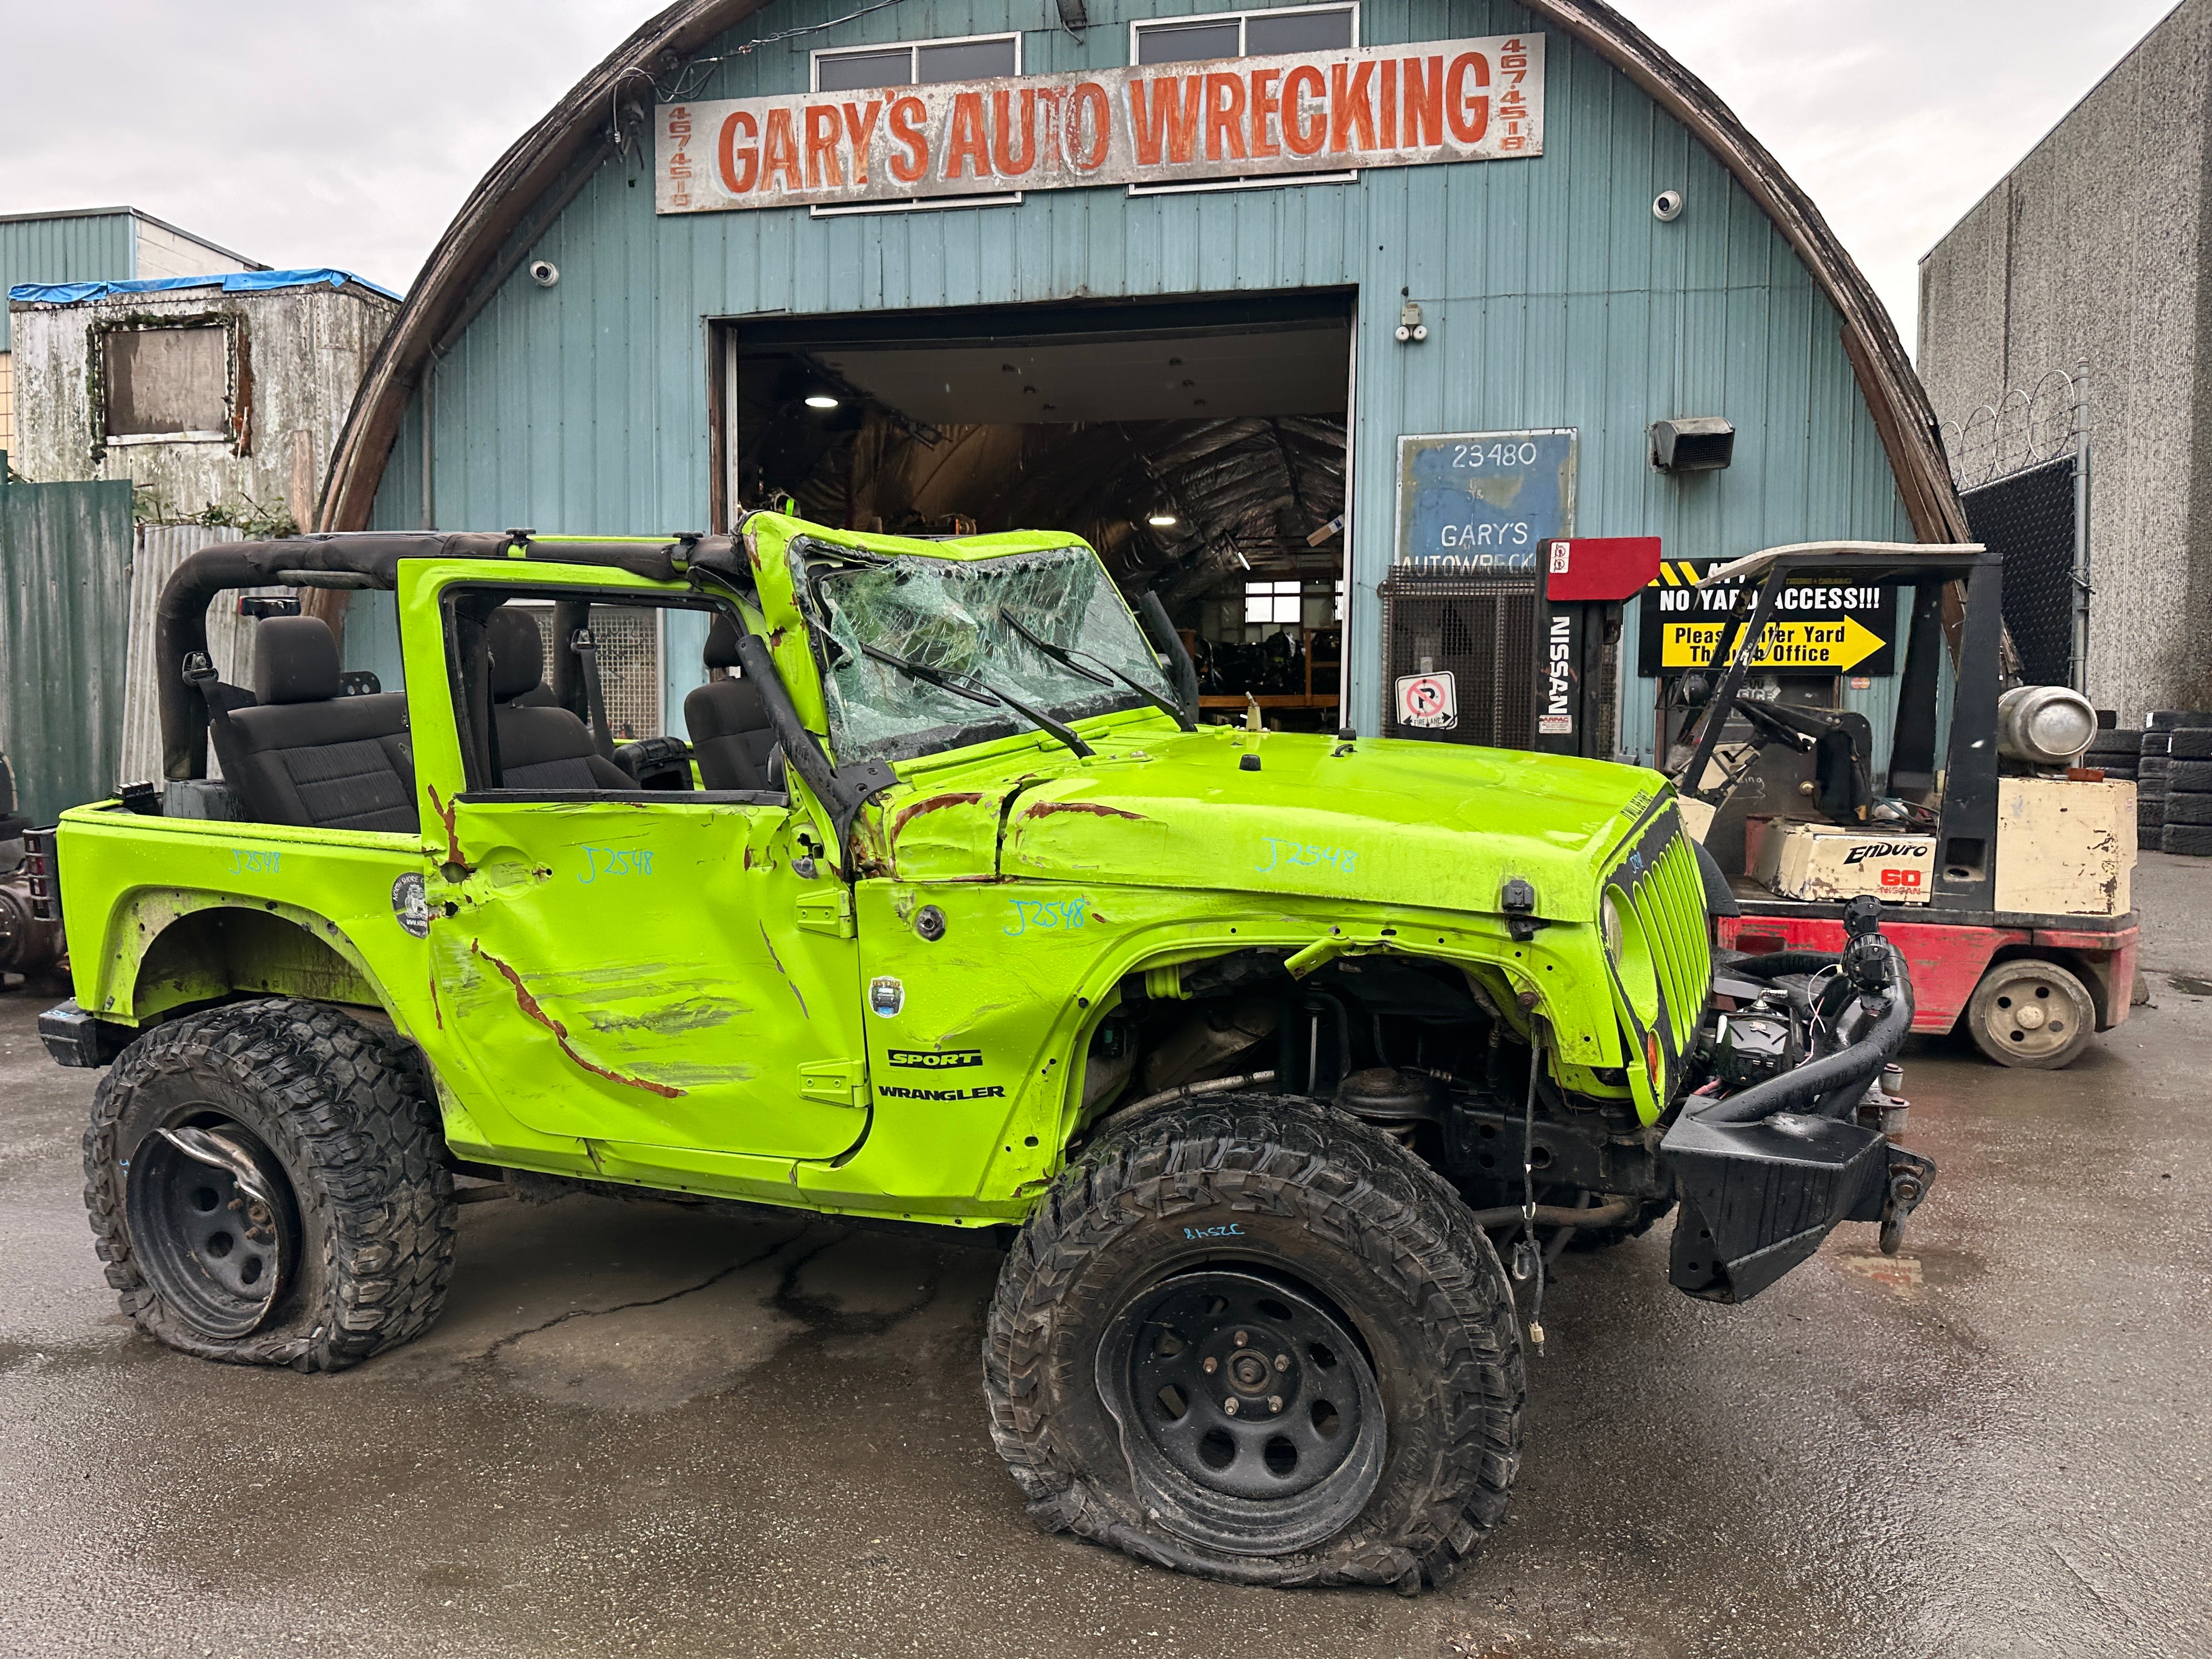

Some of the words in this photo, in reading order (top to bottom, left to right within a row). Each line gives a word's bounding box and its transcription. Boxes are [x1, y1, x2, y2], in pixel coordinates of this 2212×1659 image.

[717, 89, 929, 194] GARY'S
[945, 82, 1111, 178] AUTO
[1129, 51, 1490, 166] WRECKING
[1452, 442, 1537, 468] 23480
[1441, 521, 1528, 547] GARY'S
[1660, 589, 1690, 611] NO
[1774, 587, 1880, 610] ACCESS!!!
[1675, 627, 1724, 644] Pleas
[1745, 626, 1795, 643] nter
[1804, 626, 1845, 643] Yard
[1548, 616, 1570, 714] NISSAN
[1773, 644, 1830, 662] Office
[1414, 718, 1426, 726] FIRE
[228, 848, 282, 875] J2548
[577, 844, 654, 884] J2548
[1255, 836, 1359, 873] J2548
[1881, 869, 1921, 887] 60
[1879, 887, 1922, 895] NISSAN
[1003, 898, 1086, 937] J2548
[889, 1053, 982, 1066] SPORT
[878, 1085, 1007, 1101] WRANGLER
[1183, 1223, 1245, 1240] J2548
